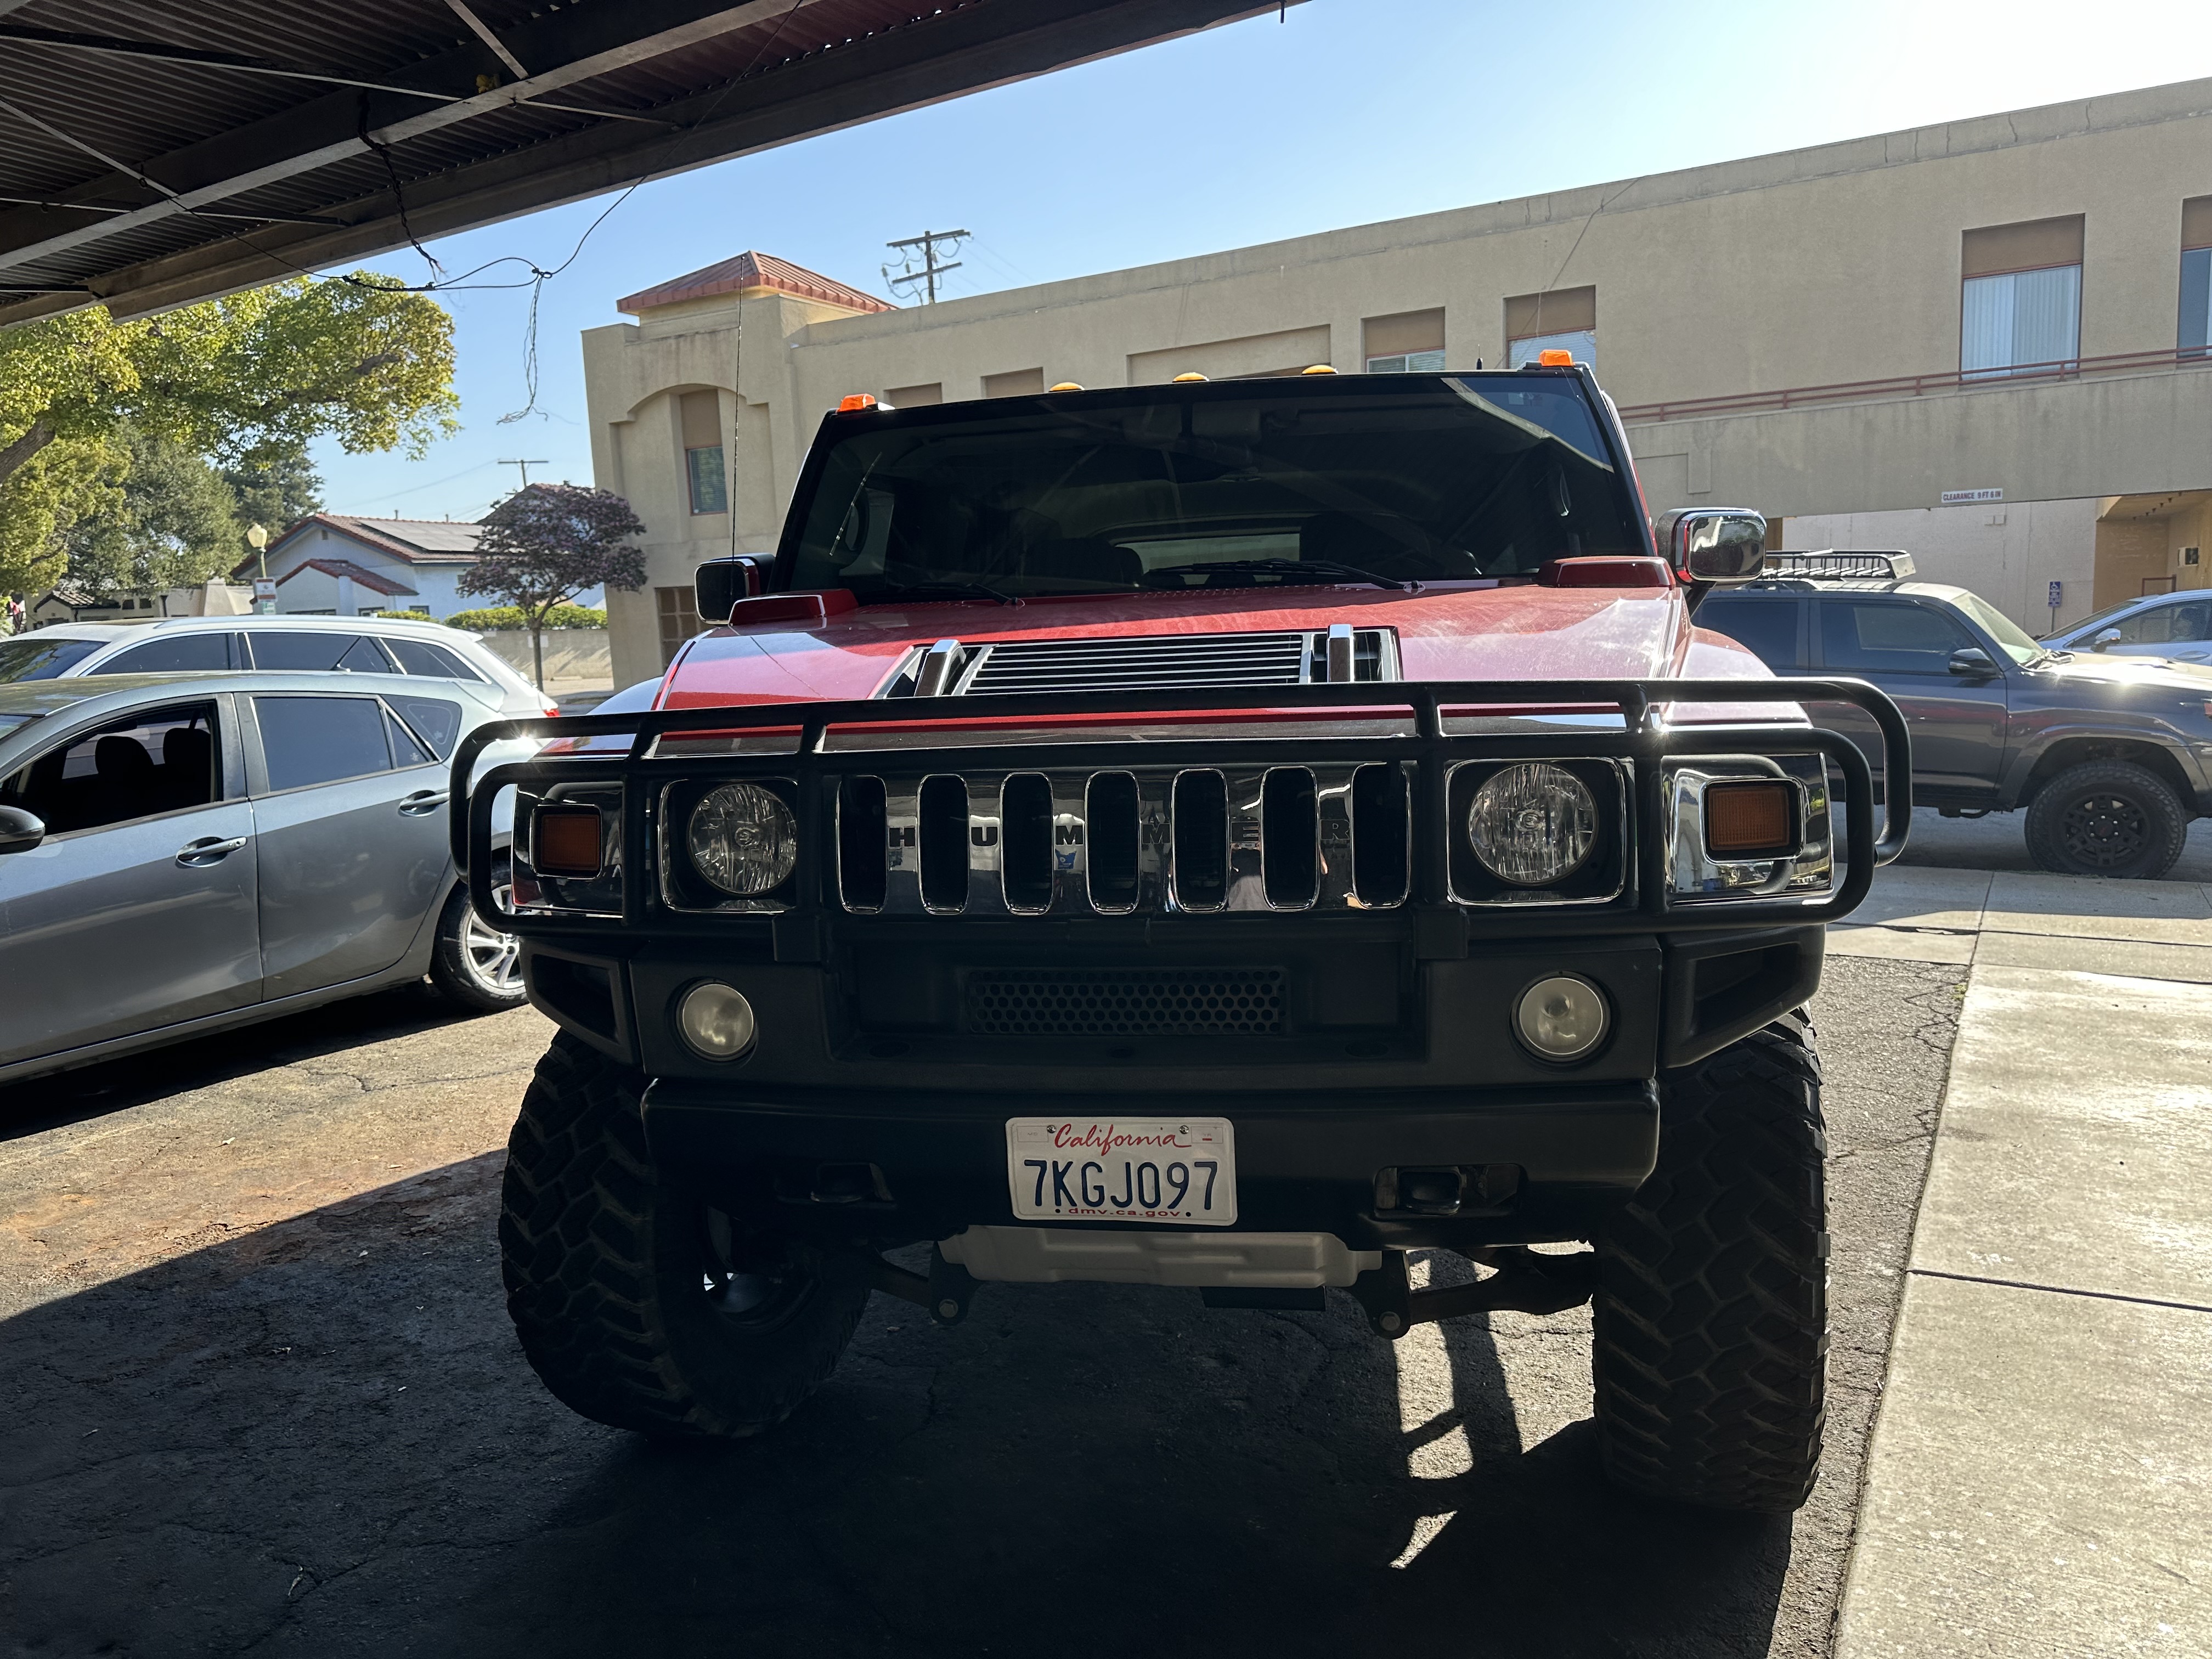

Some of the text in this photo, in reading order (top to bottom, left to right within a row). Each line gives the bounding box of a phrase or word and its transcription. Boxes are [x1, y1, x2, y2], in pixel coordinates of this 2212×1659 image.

[1943, 493, 1974, 501] CLEARANCE
[889, 819, 1350, 847] HUMMER
[1054, 1124, 1192, 1156] California
[1024, 1159, 1217, 1210] 7KGJ097
[1069, 1207, 1181, 1217] dmv.ca.gov
